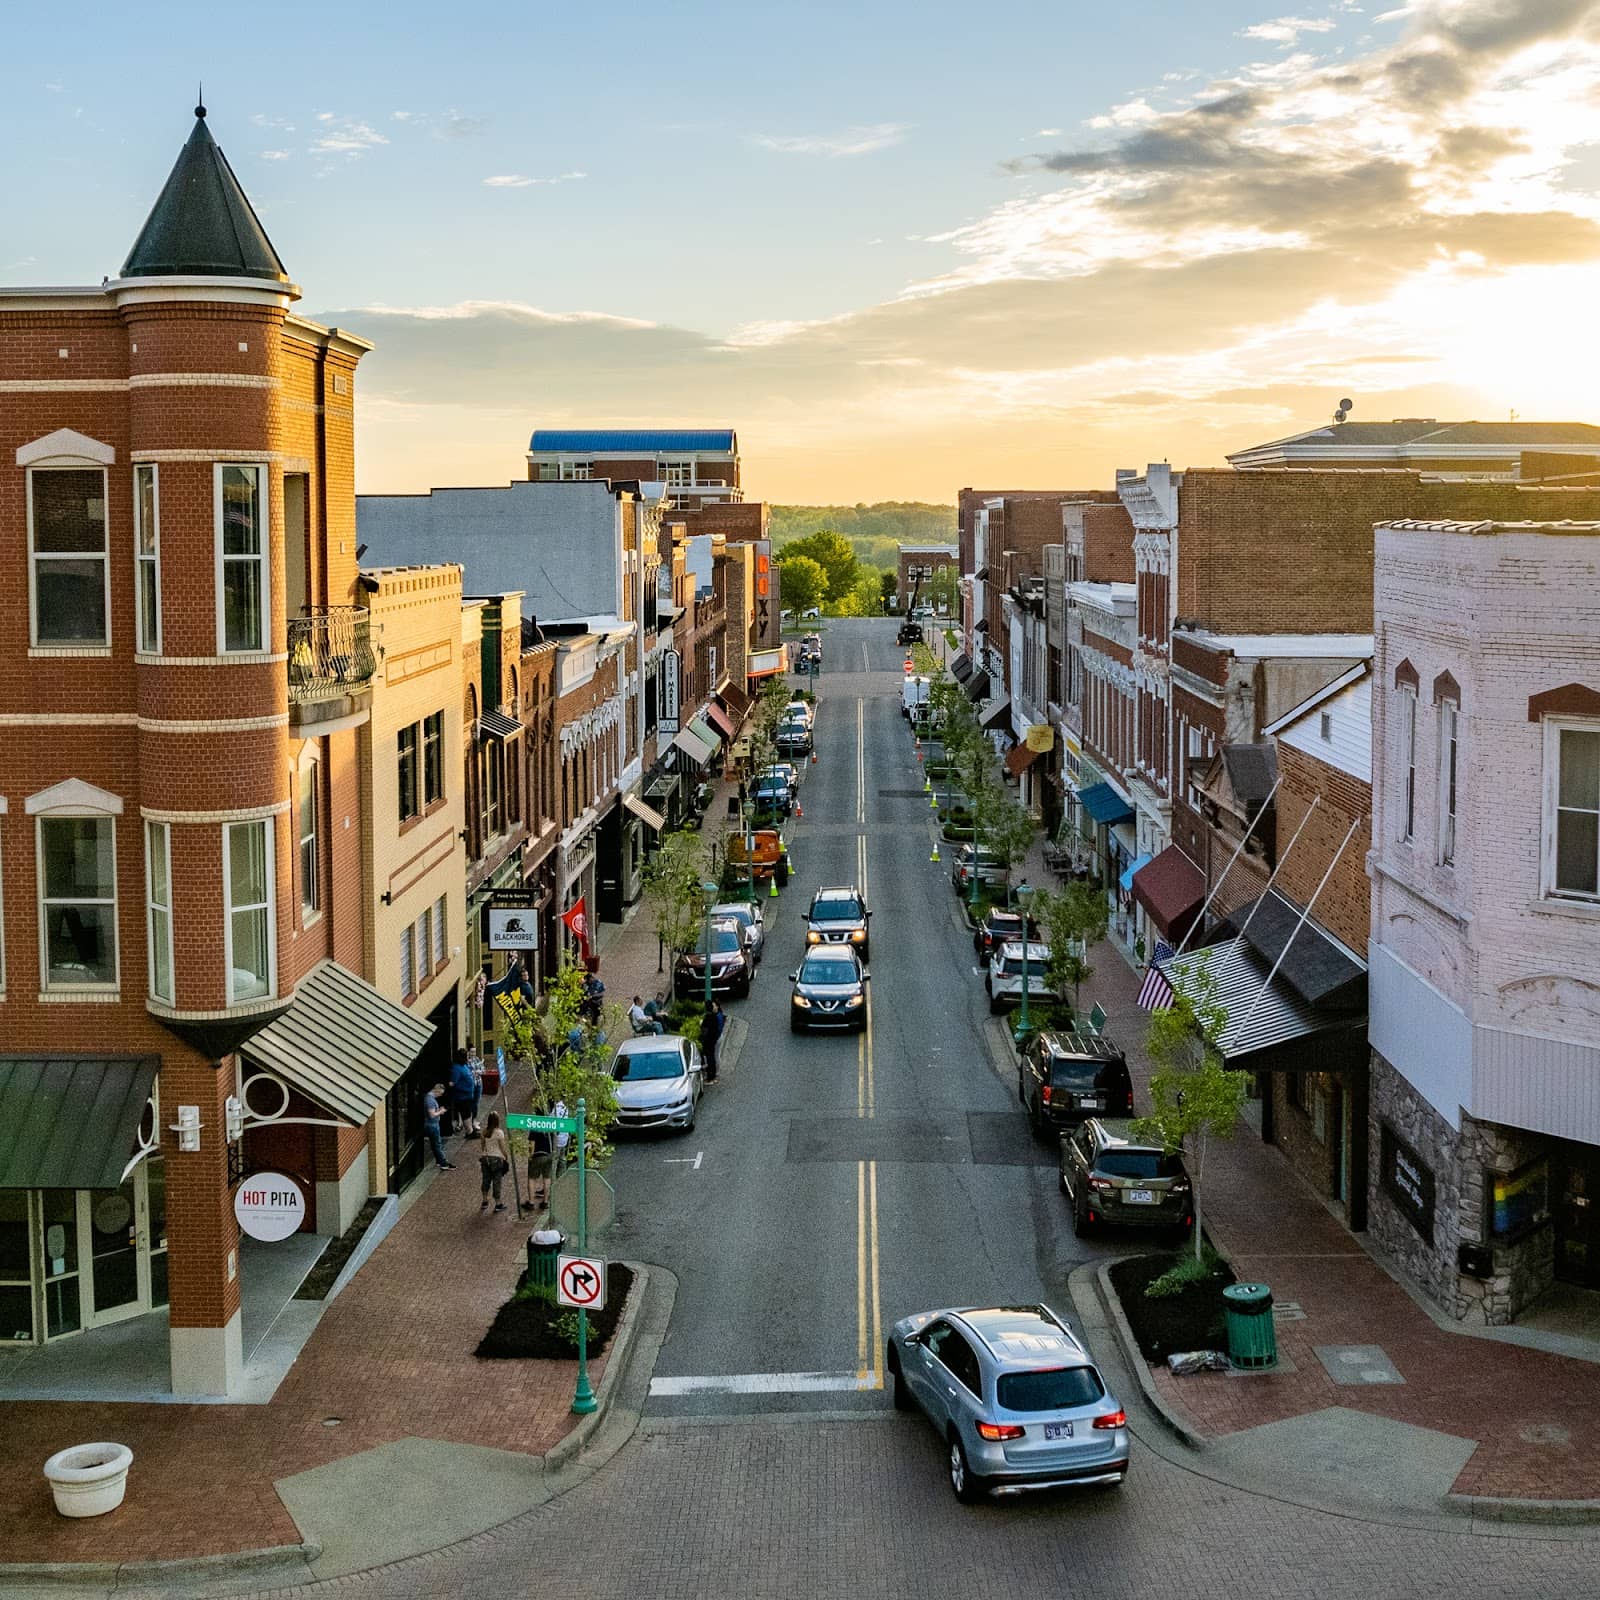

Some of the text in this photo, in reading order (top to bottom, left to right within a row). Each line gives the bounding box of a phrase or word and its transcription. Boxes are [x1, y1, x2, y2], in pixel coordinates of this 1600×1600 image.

[758, 555, 769, 639] ROXY
[494, 932, 534, 942] BLACKHORSE
[526, 1117, 557, 1130] Second
[243, 1191, 297, 1206] HOT PITA
